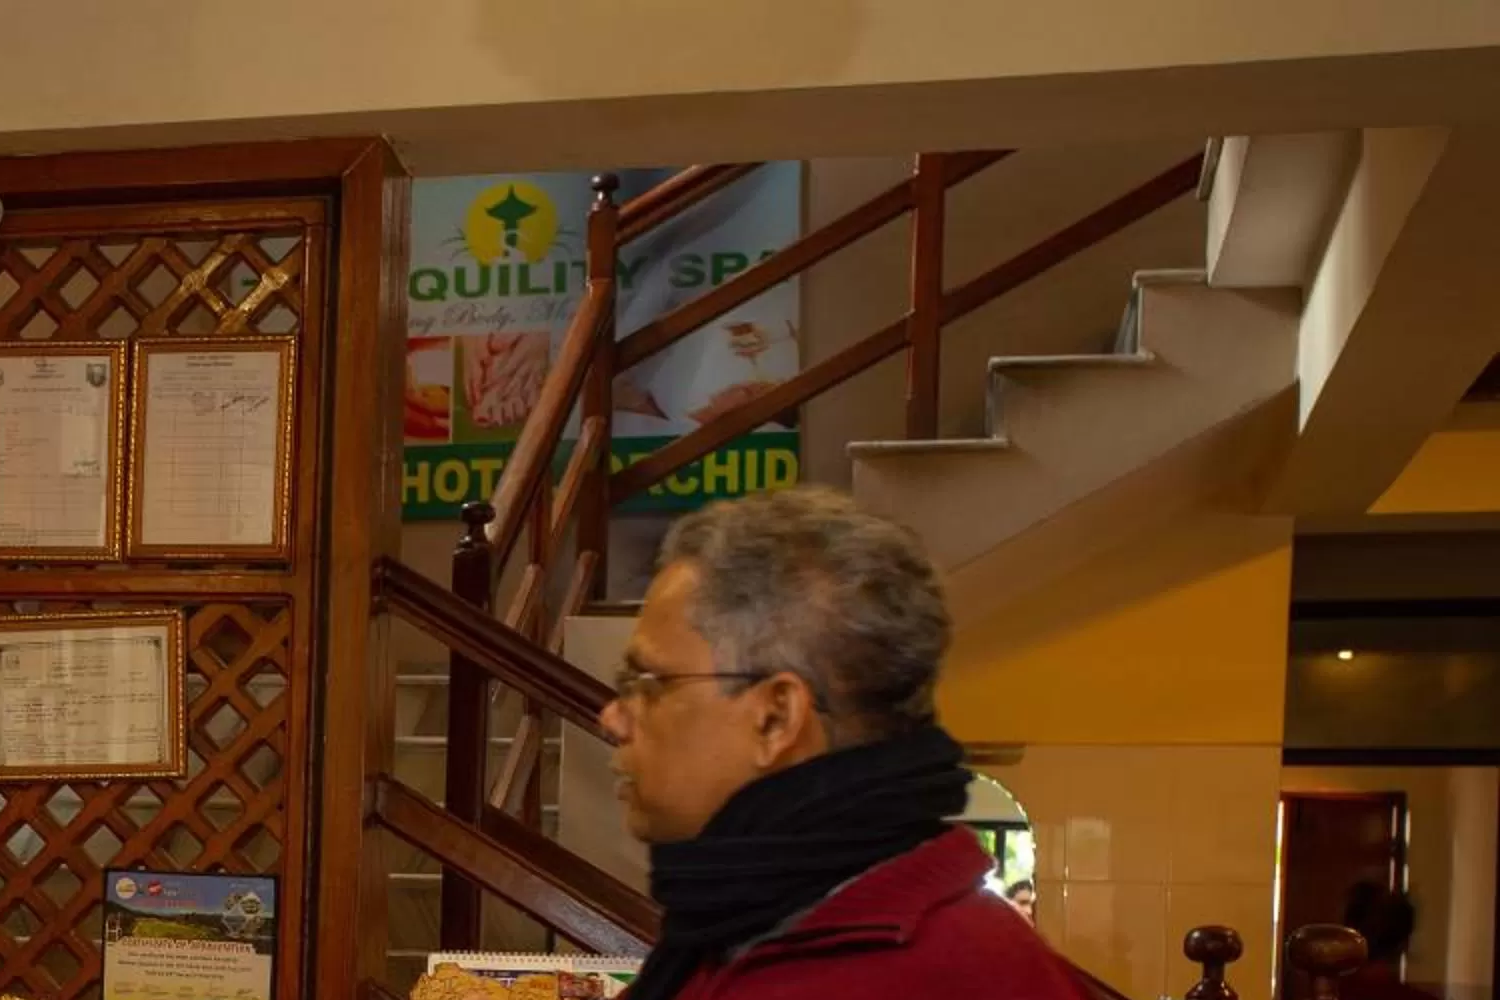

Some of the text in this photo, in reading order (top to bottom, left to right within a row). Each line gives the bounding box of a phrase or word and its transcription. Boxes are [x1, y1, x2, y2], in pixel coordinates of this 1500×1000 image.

[668, 249, 778, 289] SP
[401, 447, 799, 504] HOT CHID
